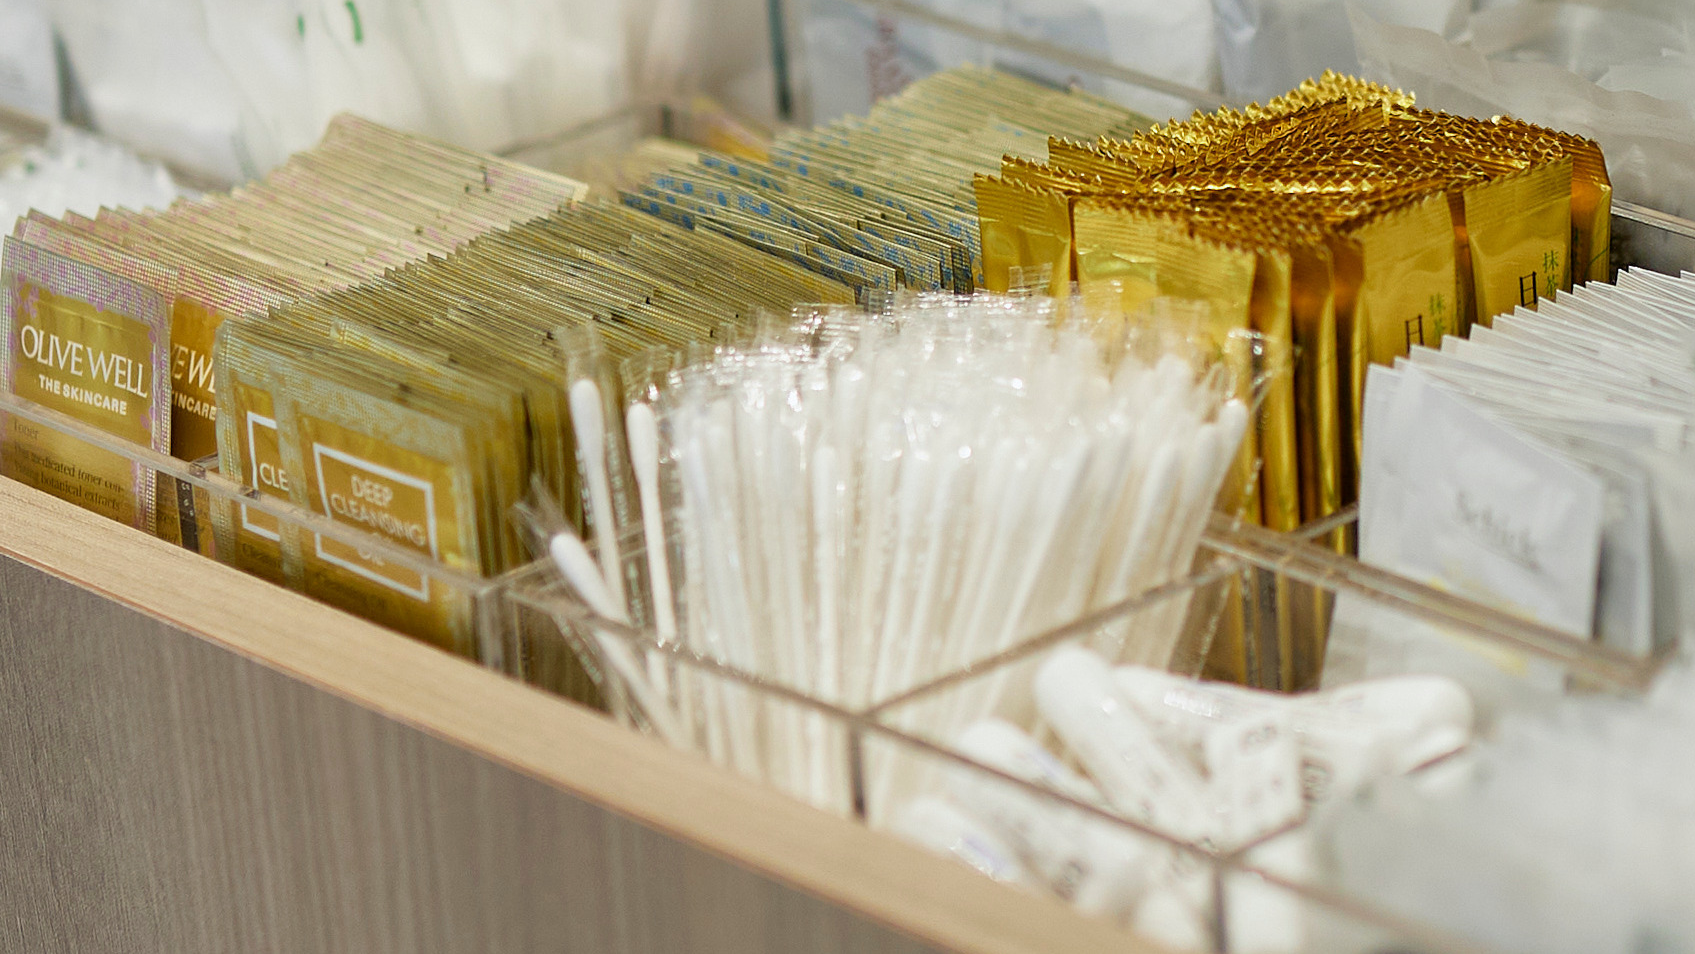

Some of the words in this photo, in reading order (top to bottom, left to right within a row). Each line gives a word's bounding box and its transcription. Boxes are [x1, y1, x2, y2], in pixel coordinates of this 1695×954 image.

[21, 324, 84, 377] OLIVE
[86, 346, 148, 399] WELL
[38, 373, 61, 394] THE
[62, 382, 128, 416] SKINCARE
[351, 474, 394, 508] DEEP
[330, 492, 426, 547] CLEANSING
